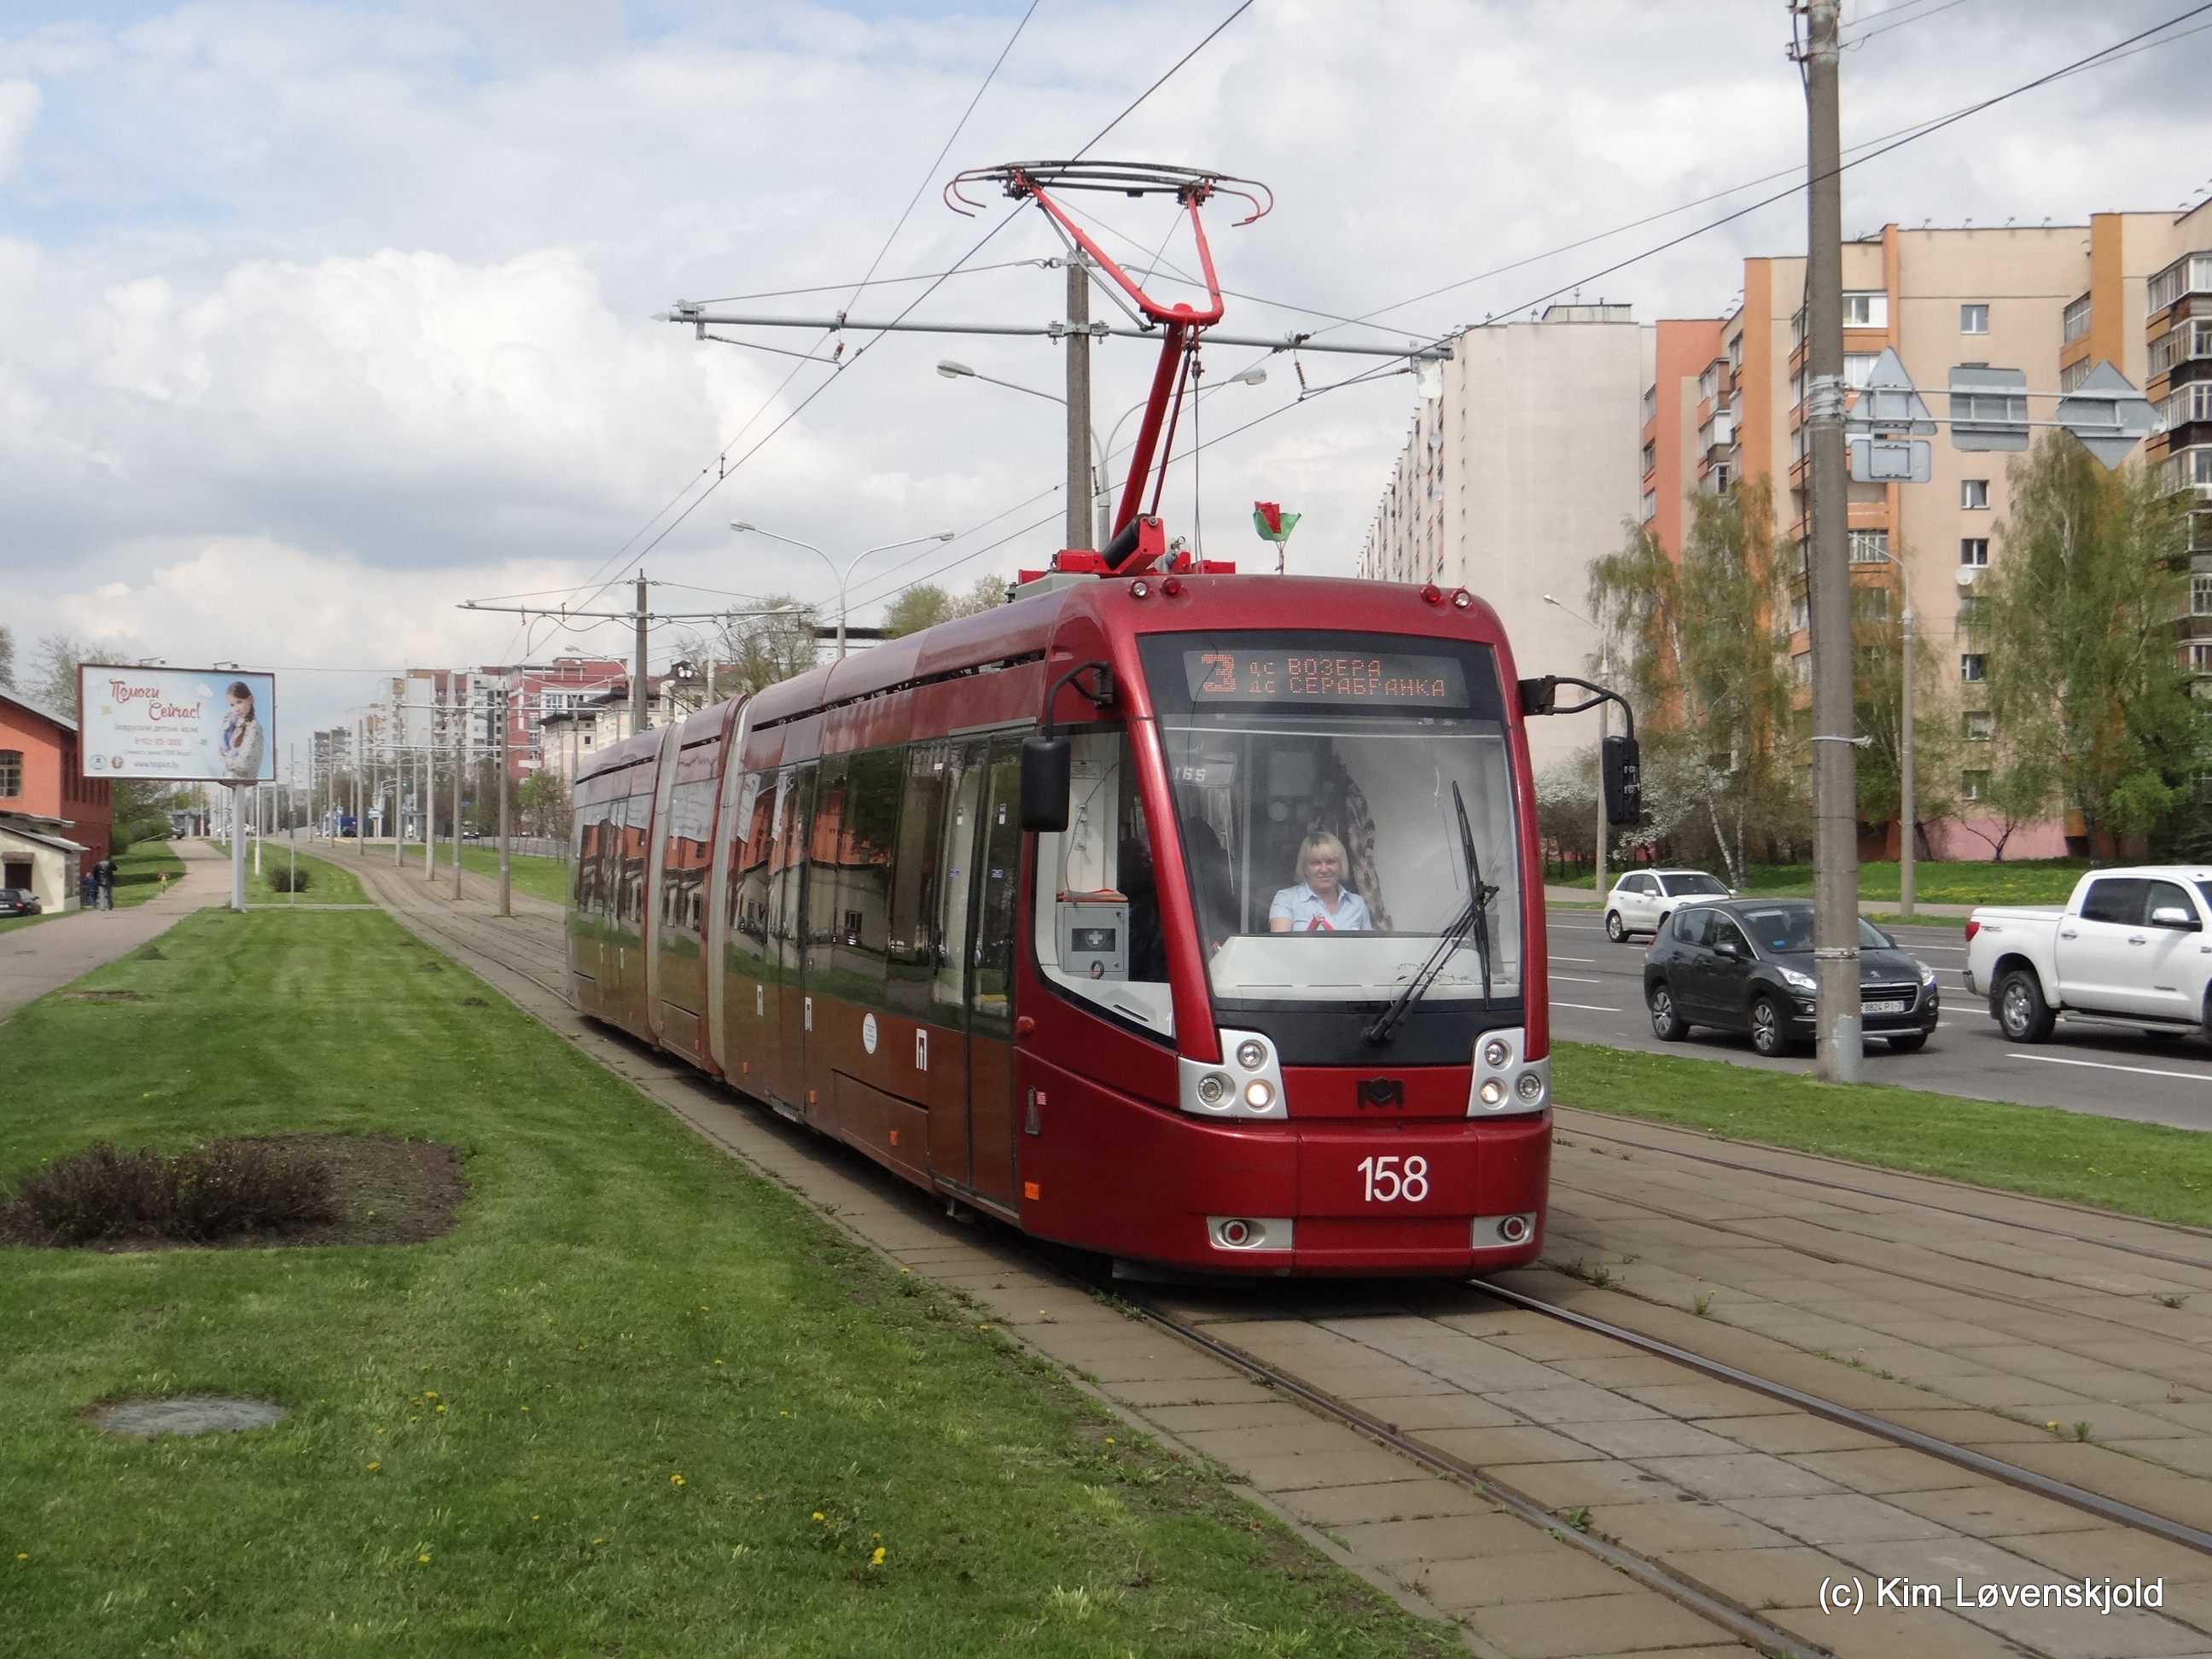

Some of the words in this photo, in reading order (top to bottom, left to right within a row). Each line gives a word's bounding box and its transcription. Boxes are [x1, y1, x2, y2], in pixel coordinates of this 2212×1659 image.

[1200, 654, 1237, 693] 3
[1288, 658, 1382, 678] ВОЗЕРА
[108, 678, 160, 703] Помоги
[1289, 677, 1447, 697] СЕРАБРАНКА
[148, 699, 201, 721] Сейчас!
[1174, 766, 1207, 782] 165
[1865, 1003, 1883, 1011] 8824
[1357, 1155, 1429, 1202] 158
